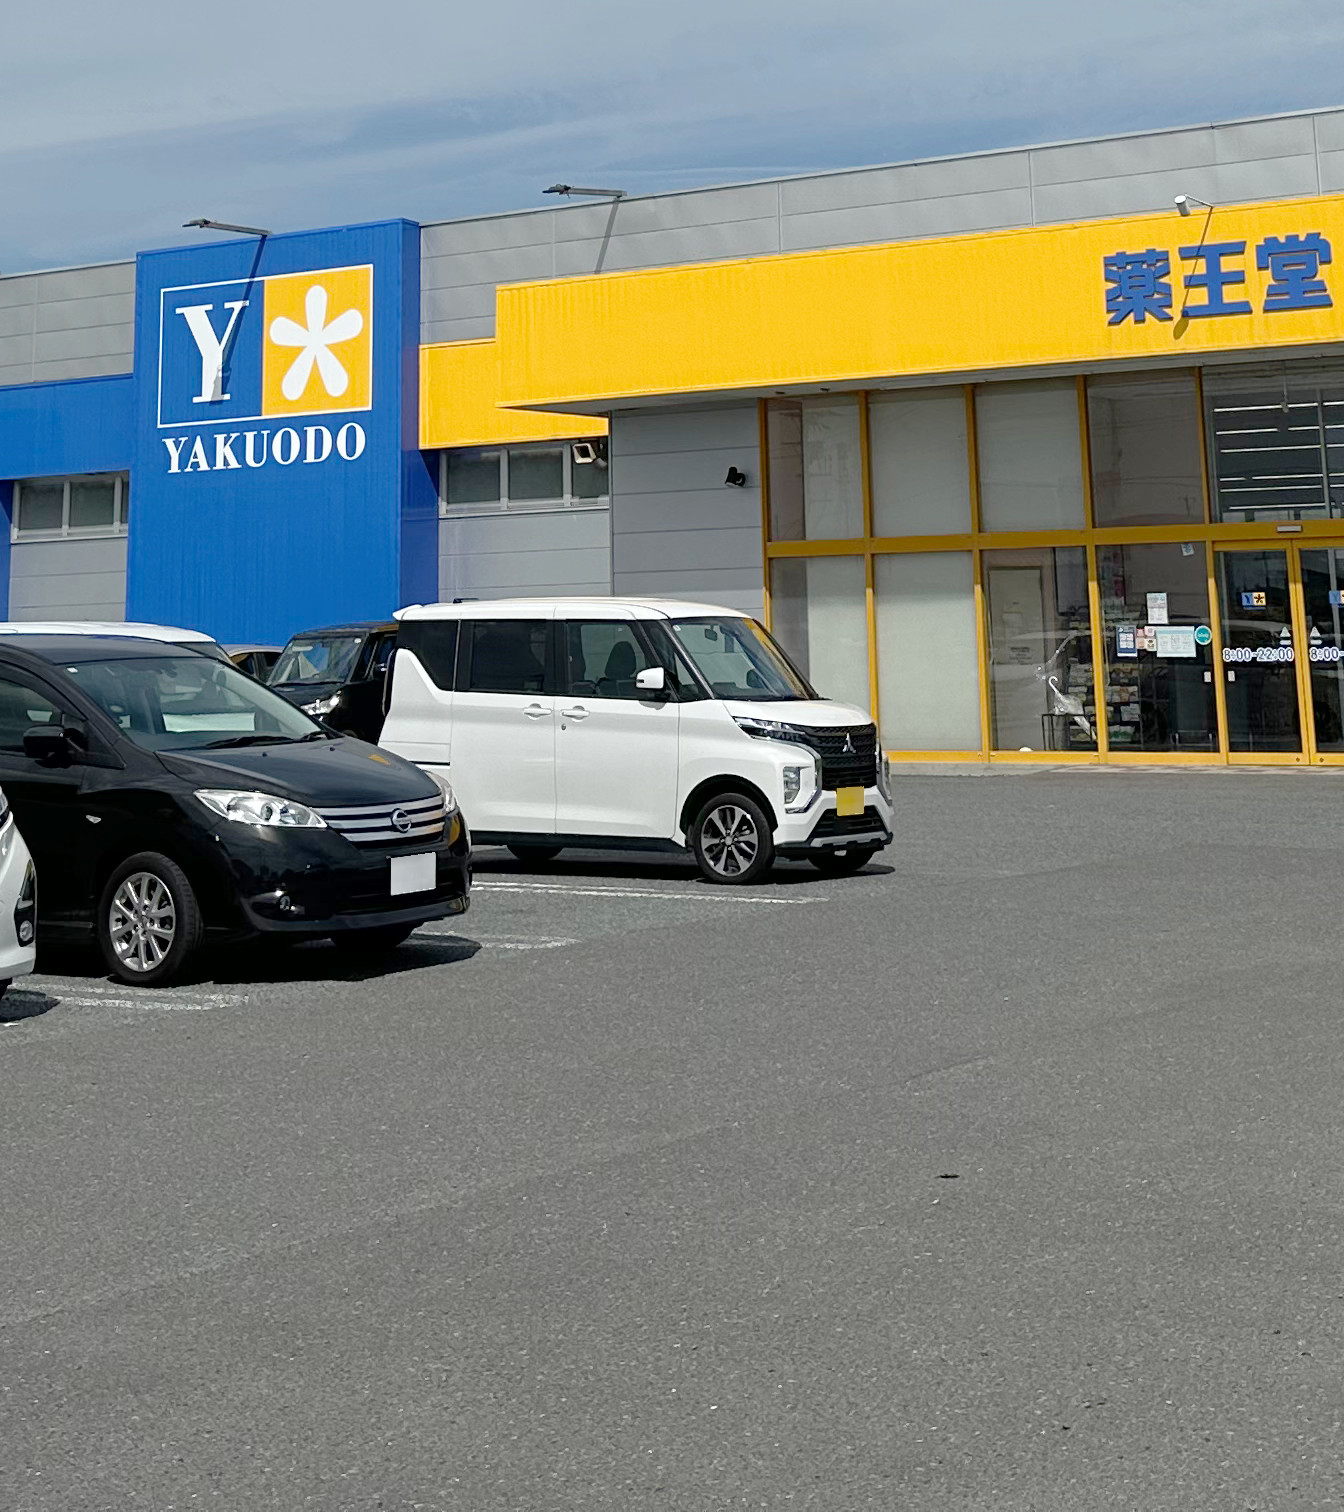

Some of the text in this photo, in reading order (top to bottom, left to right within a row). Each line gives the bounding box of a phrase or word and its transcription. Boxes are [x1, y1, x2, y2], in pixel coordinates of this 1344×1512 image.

[1102, 232, 1333, 326] 薬王堂
[175, 299, 250, 404] Y
[162, 422, 367, 474] YAKUODO
